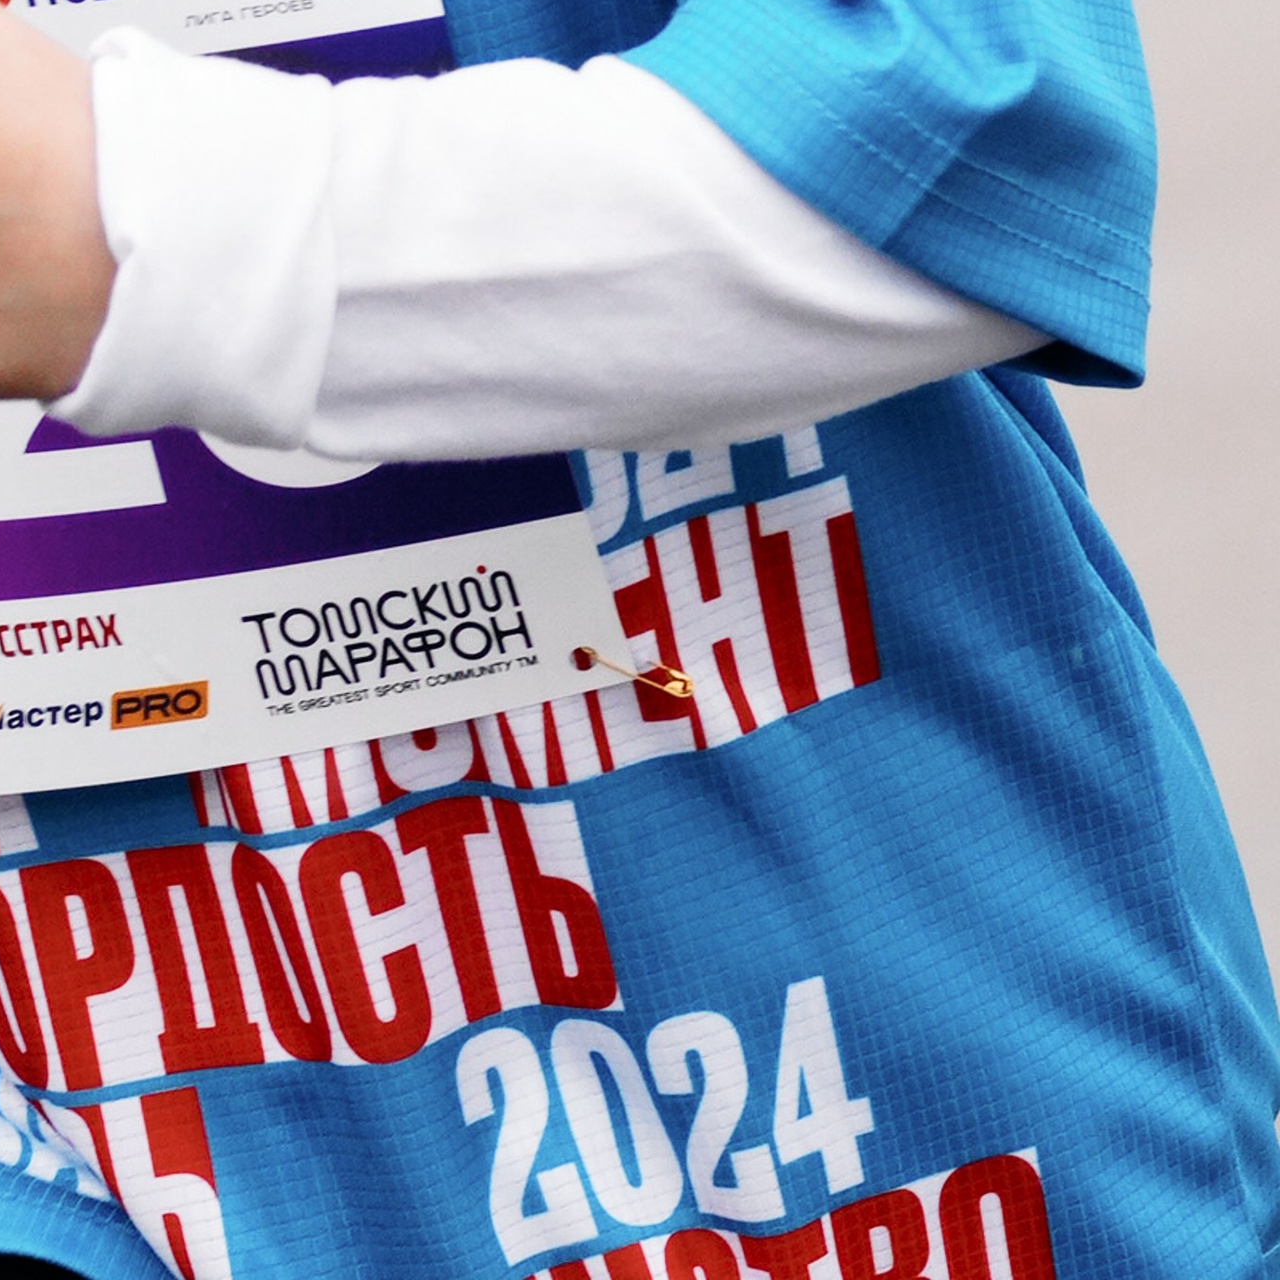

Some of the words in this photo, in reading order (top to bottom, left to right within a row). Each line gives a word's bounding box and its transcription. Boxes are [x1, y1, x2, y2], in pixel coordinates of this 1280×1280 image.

[184, 12, 235, 29] ЛИГА
[241, 565, 521, 654] ТОМСКИЙ
[255, 610, 534, 700] МАРАФОН
[267, 703, 295, 718] THE
[298, 688, 371, 712] GREATEST
[375, 678, 422, 698] SPORT
[425, 658, 513, 688] COMMUNITY
[115, 689, 203, 725] PRO
[456, 975, 875, 1267] 2024
